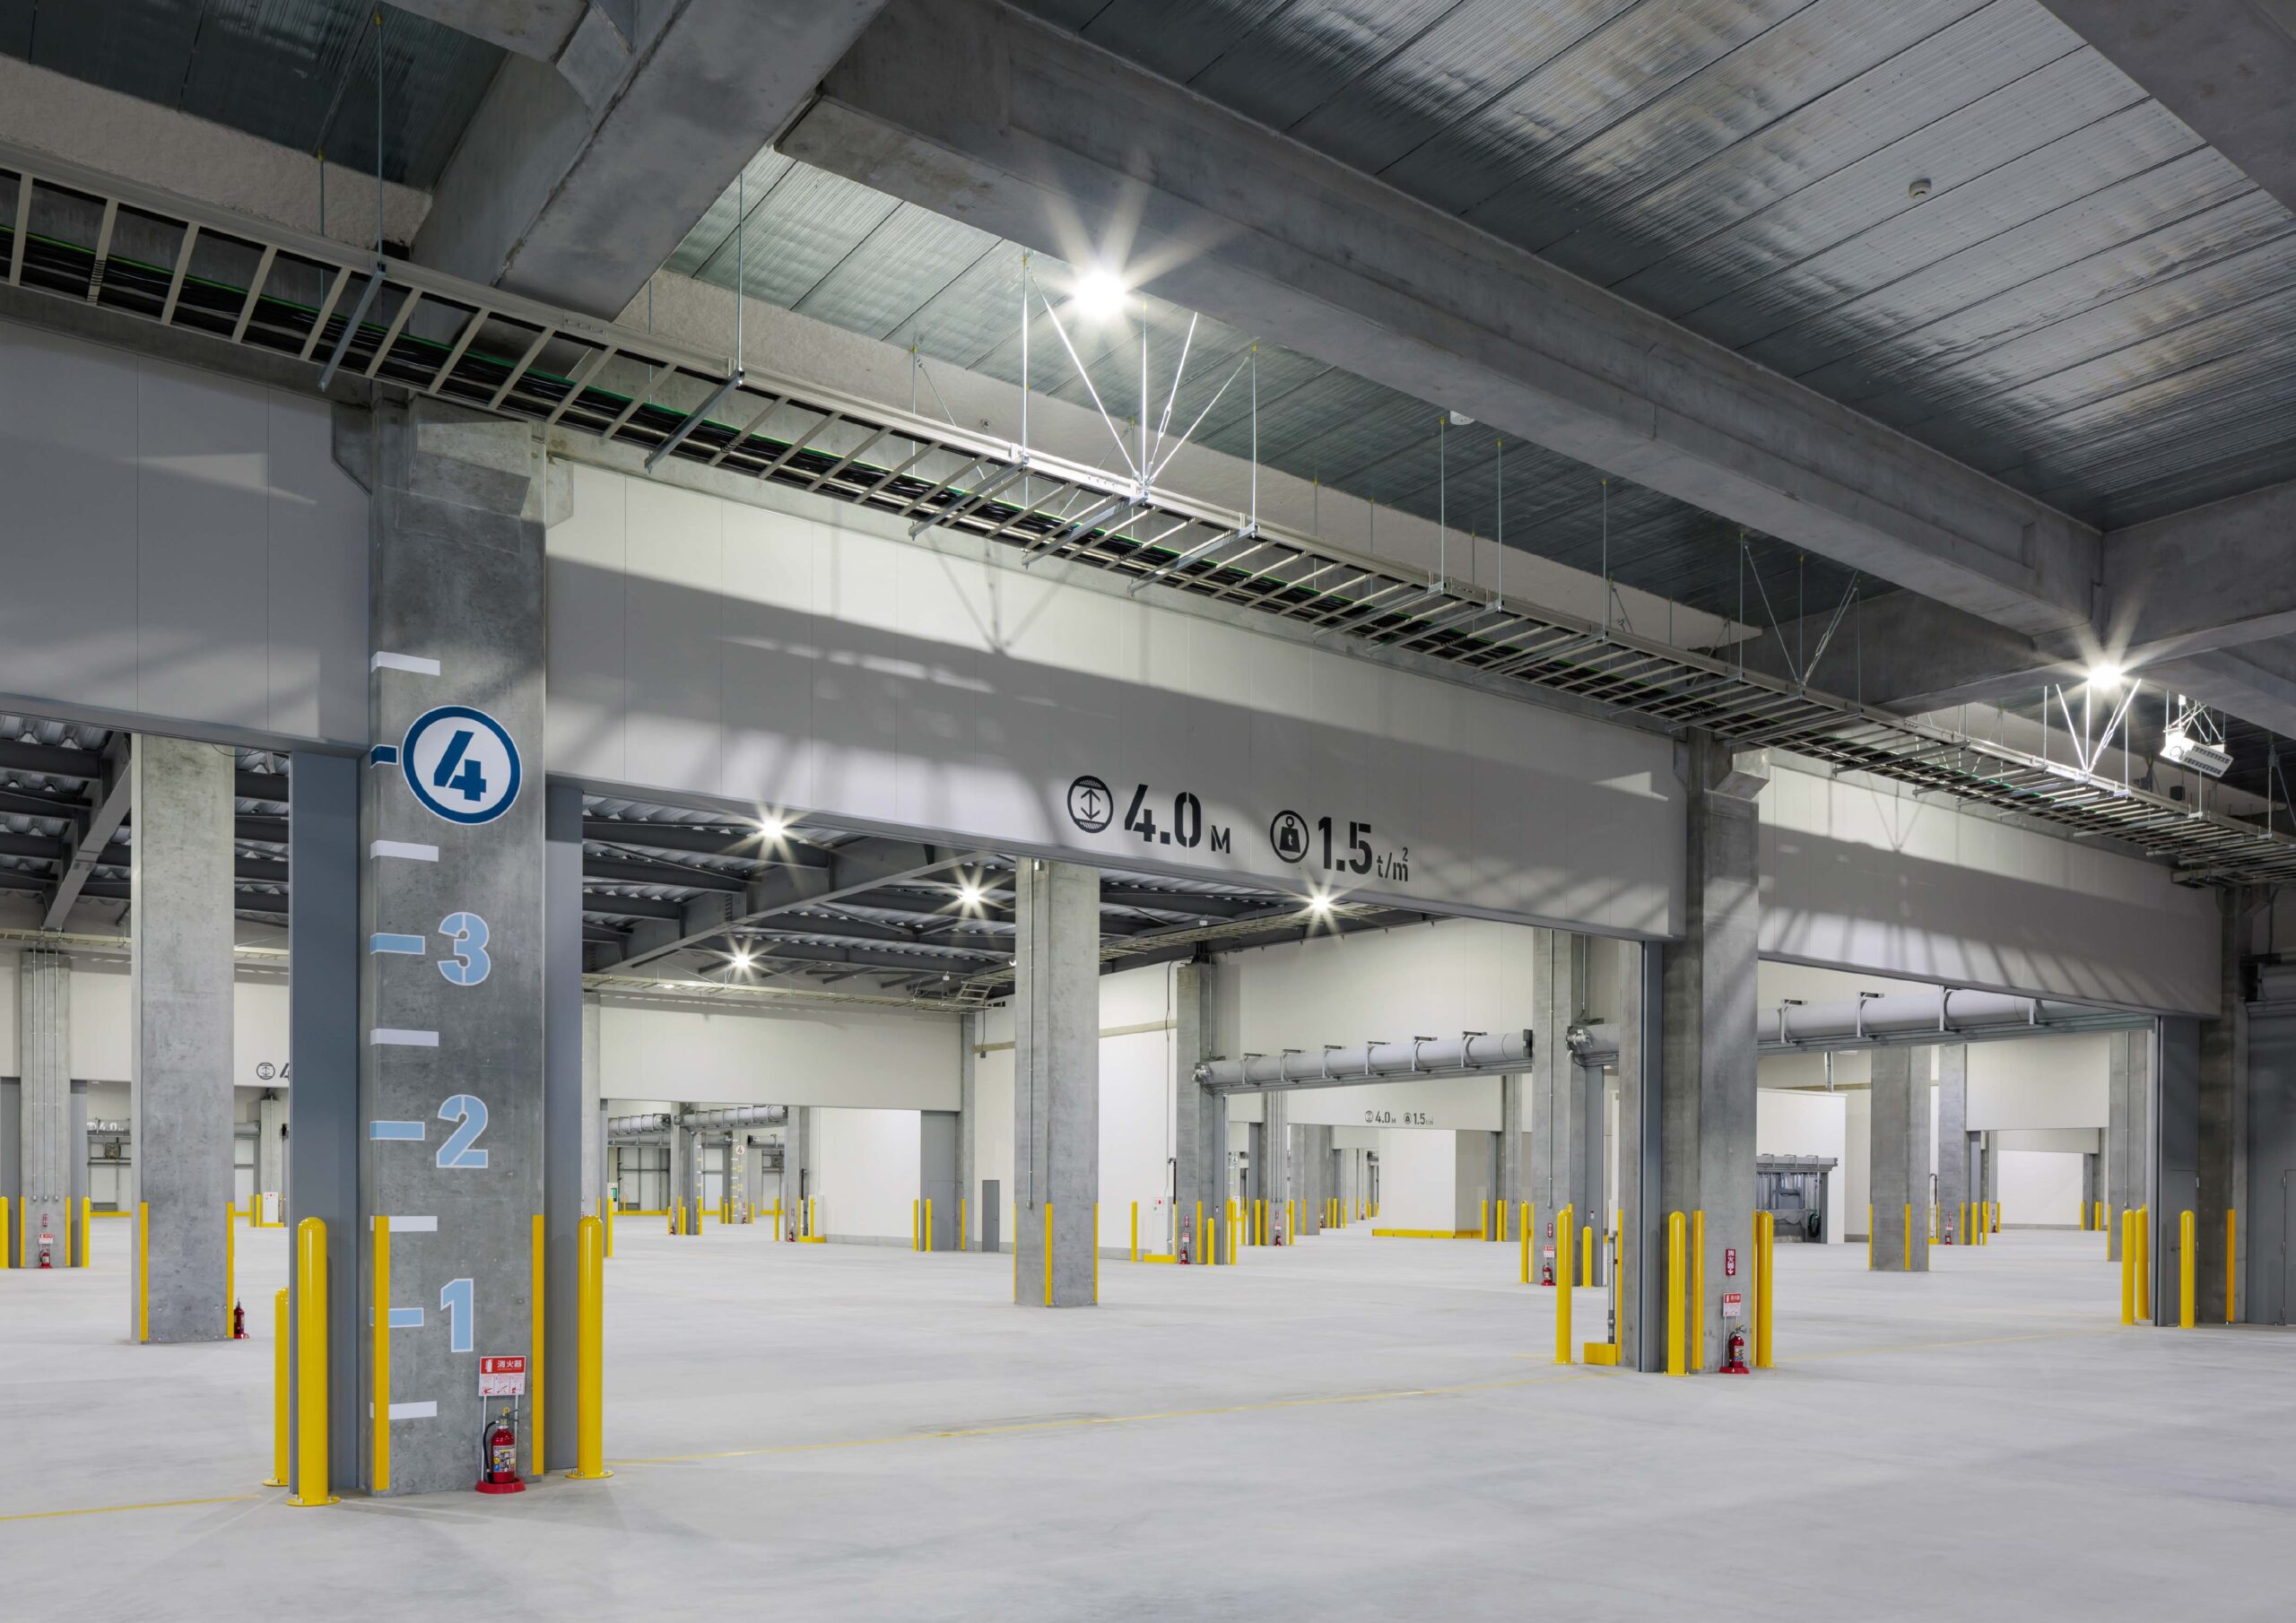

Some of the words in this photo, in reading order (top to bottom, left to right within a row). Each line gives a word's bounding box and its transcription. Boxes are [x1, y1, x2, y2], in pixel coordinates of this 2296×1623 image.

[432, 731, 487, 803] 4
[1124, 784, 1202, 849] 4.0
[1318, 816, 1372, 875] 1.5
[437, 911, 491, 986] 3
[435, 1093, 489, 1169] 2
[1375, 1111, 1391, 1124] 4.0
[1413, 1113, 1426, 1125] 1.5
[440, 1277, 474, 1353] 1
